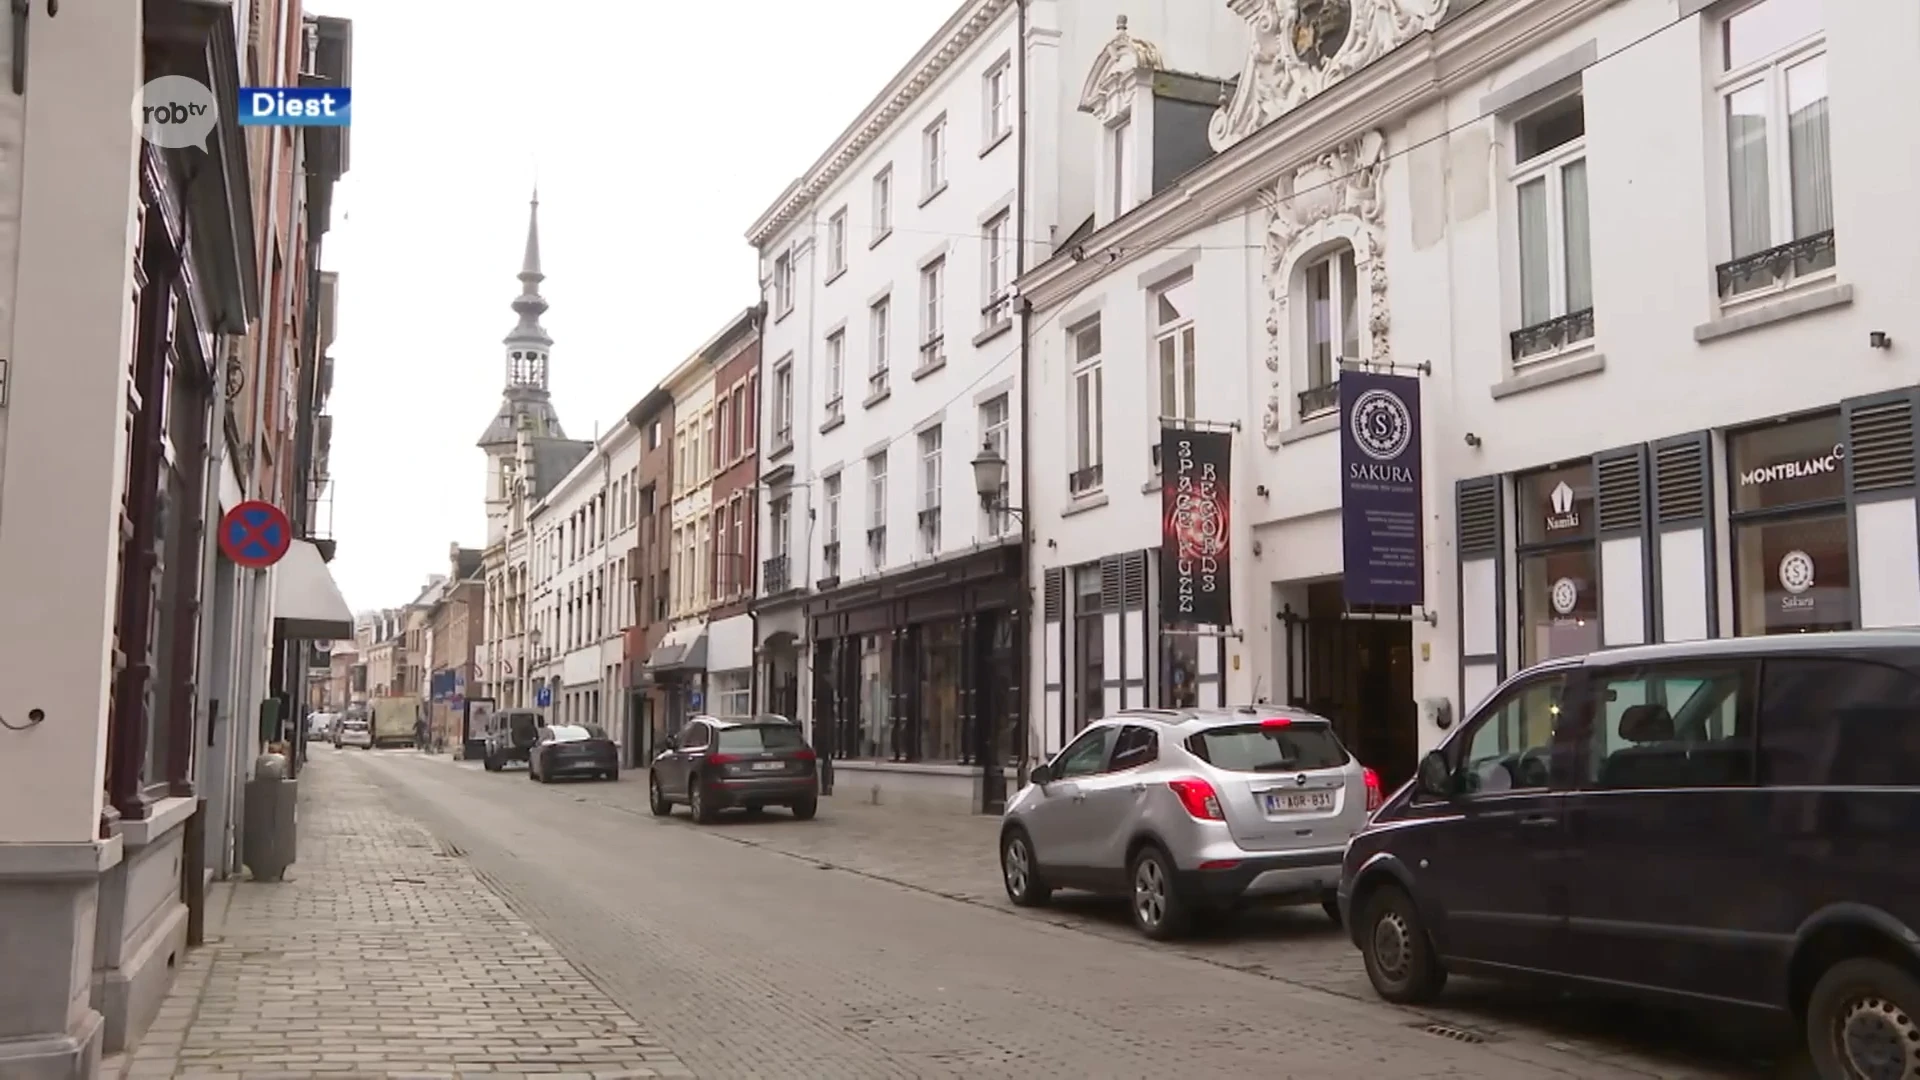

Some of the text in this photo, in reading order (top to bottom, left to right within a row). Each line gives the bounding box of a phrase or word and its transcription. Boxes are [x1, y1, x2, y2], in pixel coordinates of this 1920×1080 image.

[1350, 462, 1414, 483] SAKURA
[1176, 441, 1194, 528] SPACE
[1200, 463, 1218, 592] RECORDS
[1546, 512, 1580, 531] Namiki
[1781, 596, 1815, 609] Sakura
